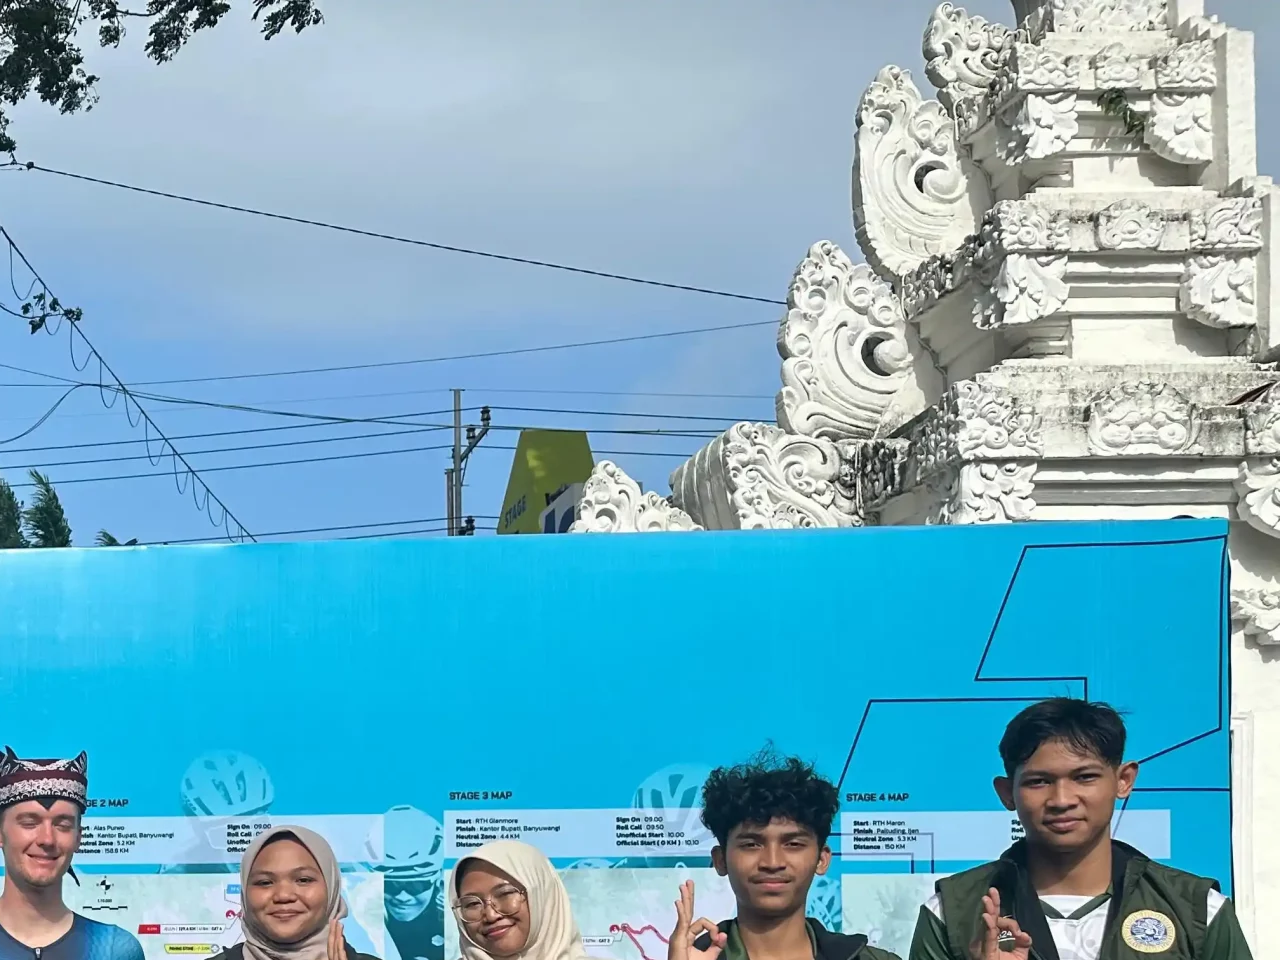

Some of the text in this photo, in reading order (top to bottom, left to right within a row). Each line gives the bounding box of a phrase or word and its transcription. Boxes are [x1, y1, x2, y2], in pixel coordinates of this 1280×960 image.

[449, 791, 512, 800] STAGE 3 MAP
[846, 793, 909, 802] STAGE 4 MAP
[99, 799, 106, 807] 2
[108, 799, 129, 807] MAP
